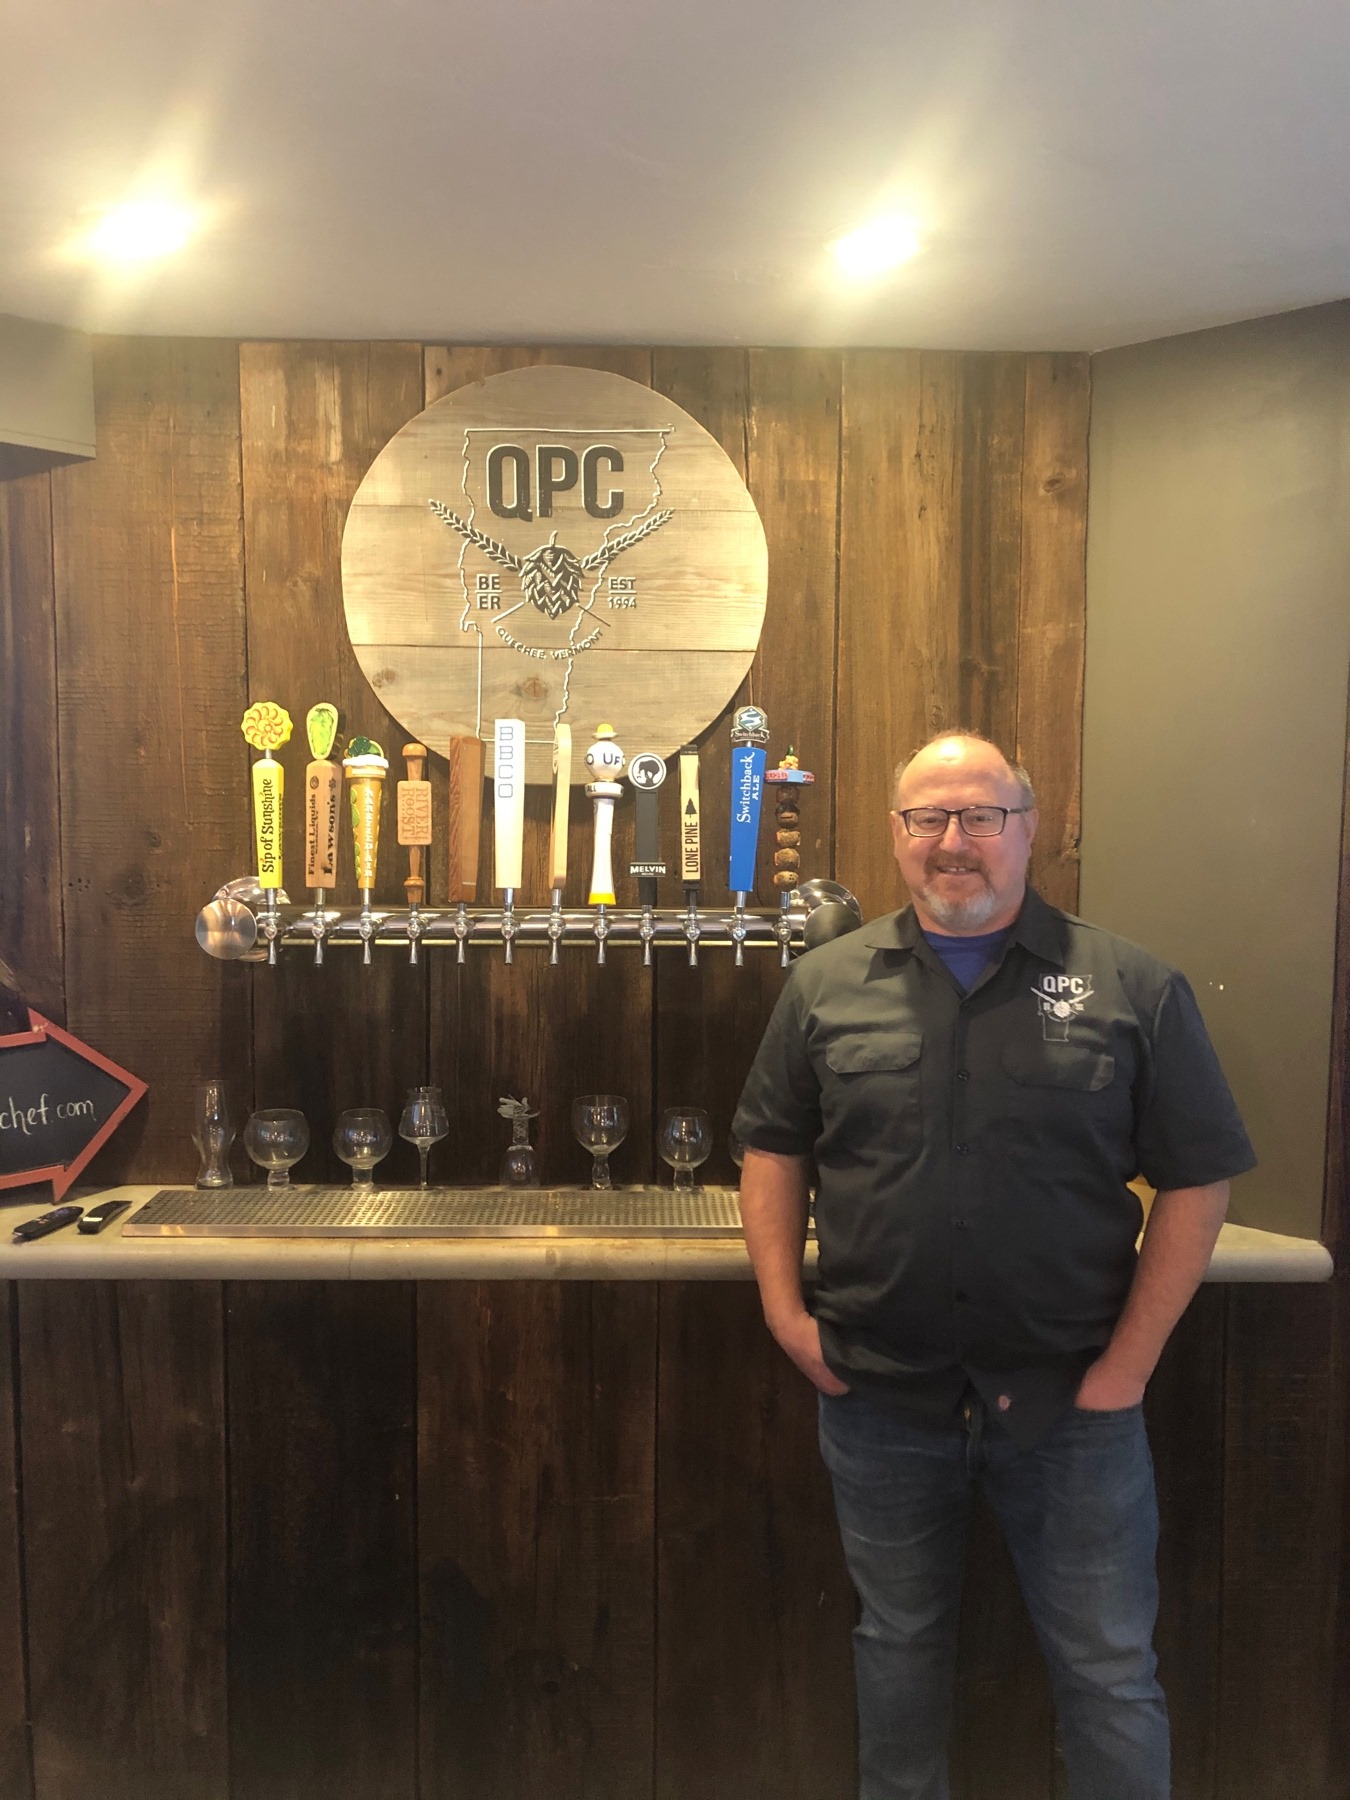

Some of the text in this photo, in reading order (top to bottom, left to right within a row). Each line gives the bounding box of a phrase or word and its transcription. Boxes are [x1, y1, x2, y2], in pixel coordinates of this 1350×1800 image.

[486, 443, 624, 522] QPC
[476, 574, 501, 591] BE
[608, 577, 637, 591] EST
[476, 594, 501, 610] ER
[608, 597, 637, 609] 1994
[551, 626, 604, 660] VERMONT
[736, 751, 756, 823] Switchback
[751, 774, 760, 801] ALE
[260, 778, 276, 873] Sip of Sunshine
[308, 794, 318, 837] Liquids
[401, 787, 416, 836] ROOST
[416, 787, 429, 836] RIVER
[308, 840, 316, 875] Finest
[684, 821, 699, 874] LONE PINE
[630, 865, 666, 875] MELVIN
[1043, 975, 1084, 994] QPC
